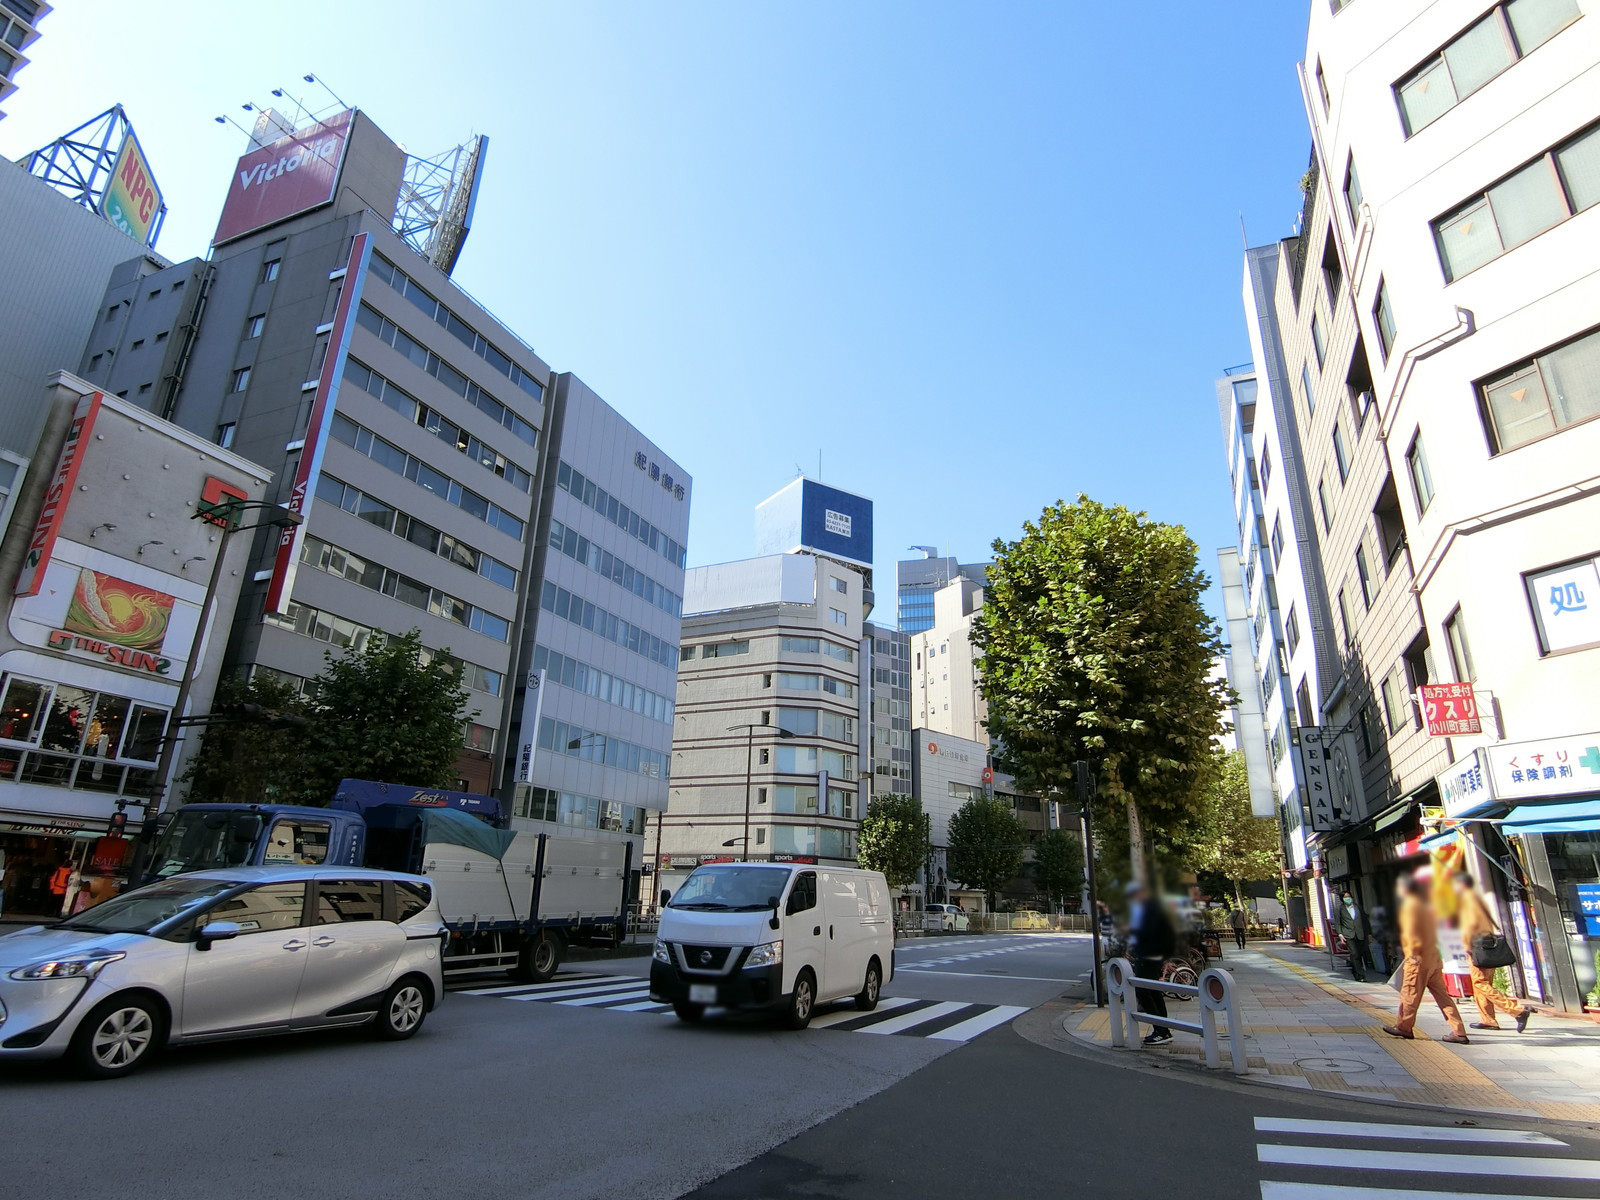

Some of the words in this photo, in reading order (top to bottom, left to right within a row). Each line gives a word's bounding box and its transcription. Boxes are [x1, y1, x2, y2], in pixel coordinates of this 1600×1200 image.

[240, 138, 338, 191] Victoria
[120, 147, 154, 224] NPC
[56, 443, 79, 483] THE
[1549, 582, 1587, 616] 処
[74, 636, 109, 655] THE
[1424, 685, 1471, 699] 処方せん受付
[1426, 698, 1475, 720] クスリ
[1429, 718, 1480, 734] 小川町薬局
[520, 743, 531, 780] 紀陽銀行
[1509, 750, 1569, 769] くすり
[1305, 733, 1329, 824] GENSAN
[1450, 750, 1483, 803] 小川町薬局
[1511, 764, 1573, 784] 保険調剤
[408, 790, 440, 804] Zest
